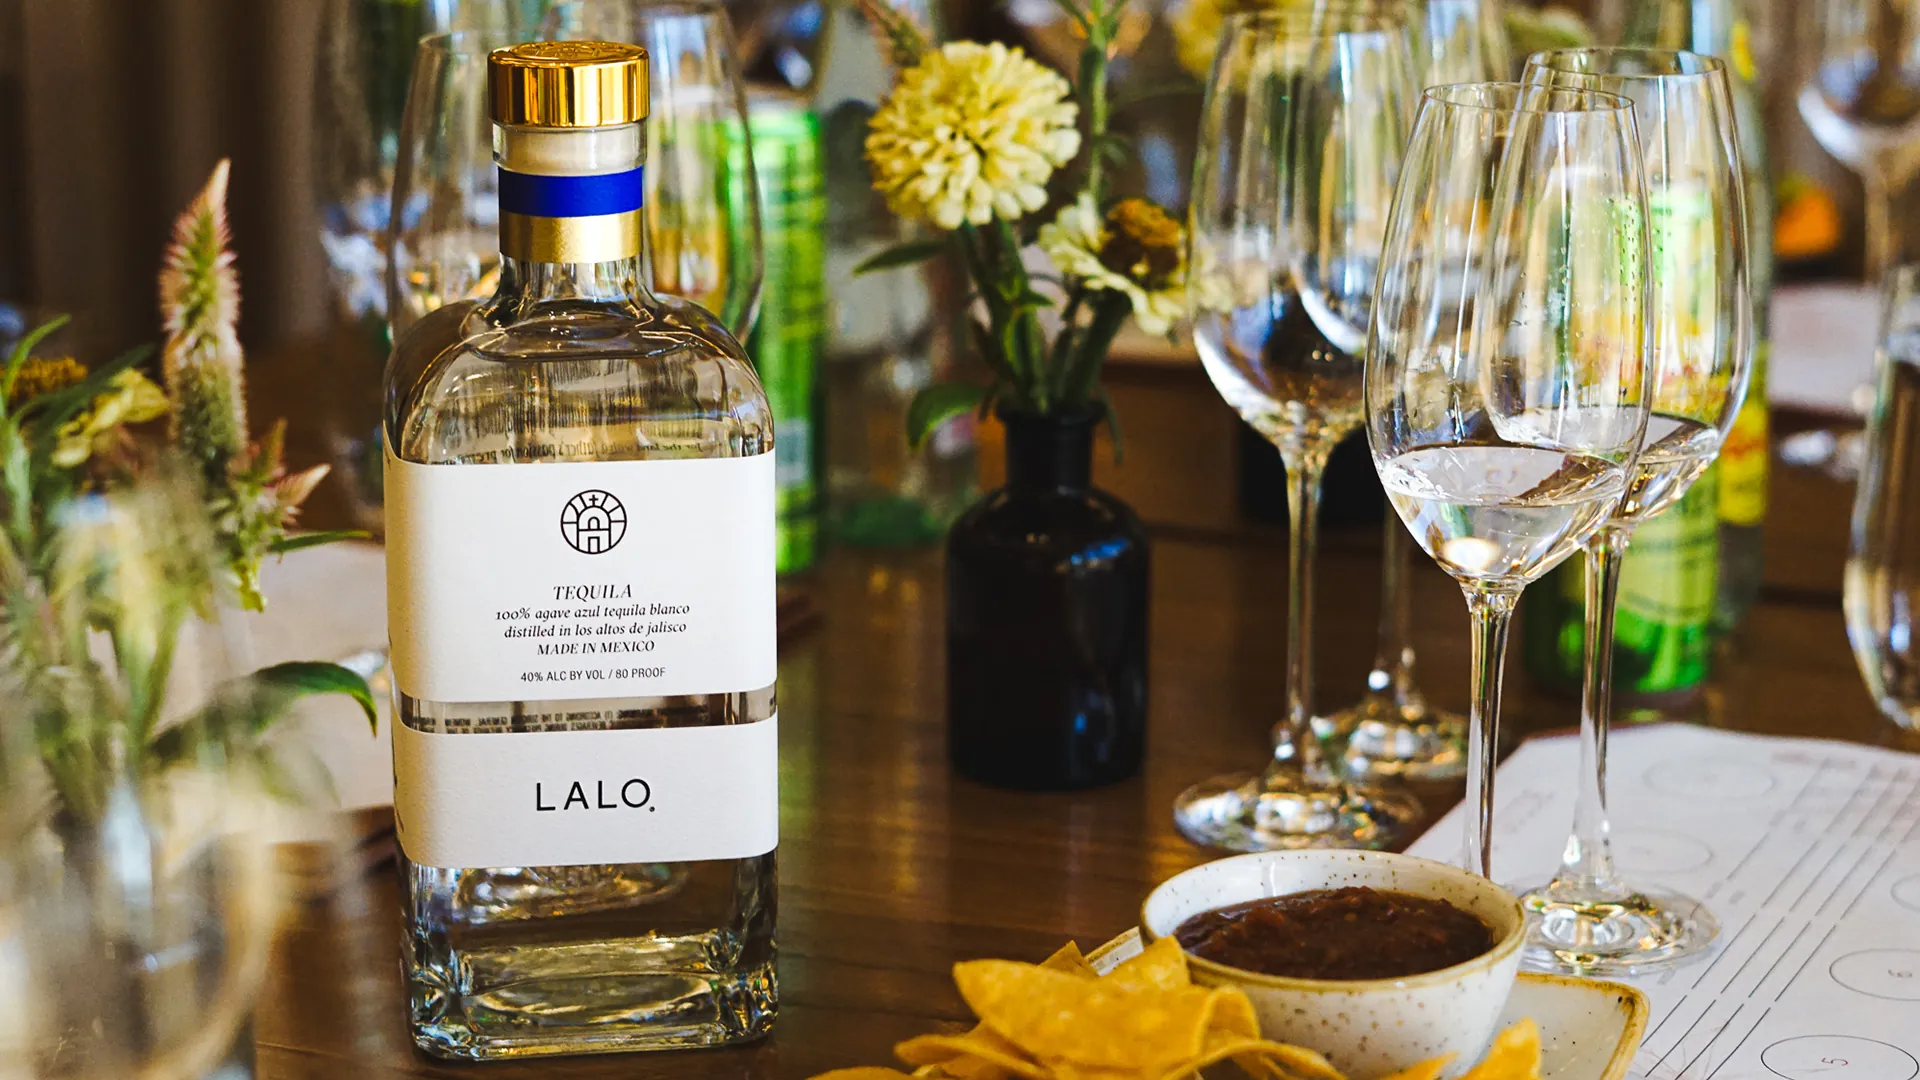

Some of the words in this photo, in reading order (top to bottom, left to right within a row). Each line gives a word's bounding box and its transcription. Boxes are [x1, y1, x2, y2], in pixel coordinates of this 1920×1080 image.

[553, 584, 632, 602] TEQUILA
[495, 607, 531, 620] 100%
[534, 609, 571, 622] agave
[574, 605, 601, 618] azul
[603, 604, 646, 620] tequila
[649, 603, 690, 616] blanco
[504, 625, 555, 638] distilled
[559, 625, 571, 636] in
[575, 624, 593, 636] los
[595, 623, 626, 635] altos
[628, 622, 644, 634] de
[645, 621, 687, 637] jalisco
[537, 643, 579, 655] MADE
[582, 643, 597, 654] IN
[600, 640, 655, 653] MEXICO
[520, 672, 544, 682] 40%
[546, 671, 567, 681] ALC
[569, 671, 583, 680] BY
[585, 669, 605, 680] VOL
[608, 669, 613, 679] /
[615, 669, 629, 679] 80
[631, 667, 666, 678] PROOF
[1821, 1058, 1849, 1067] 5
